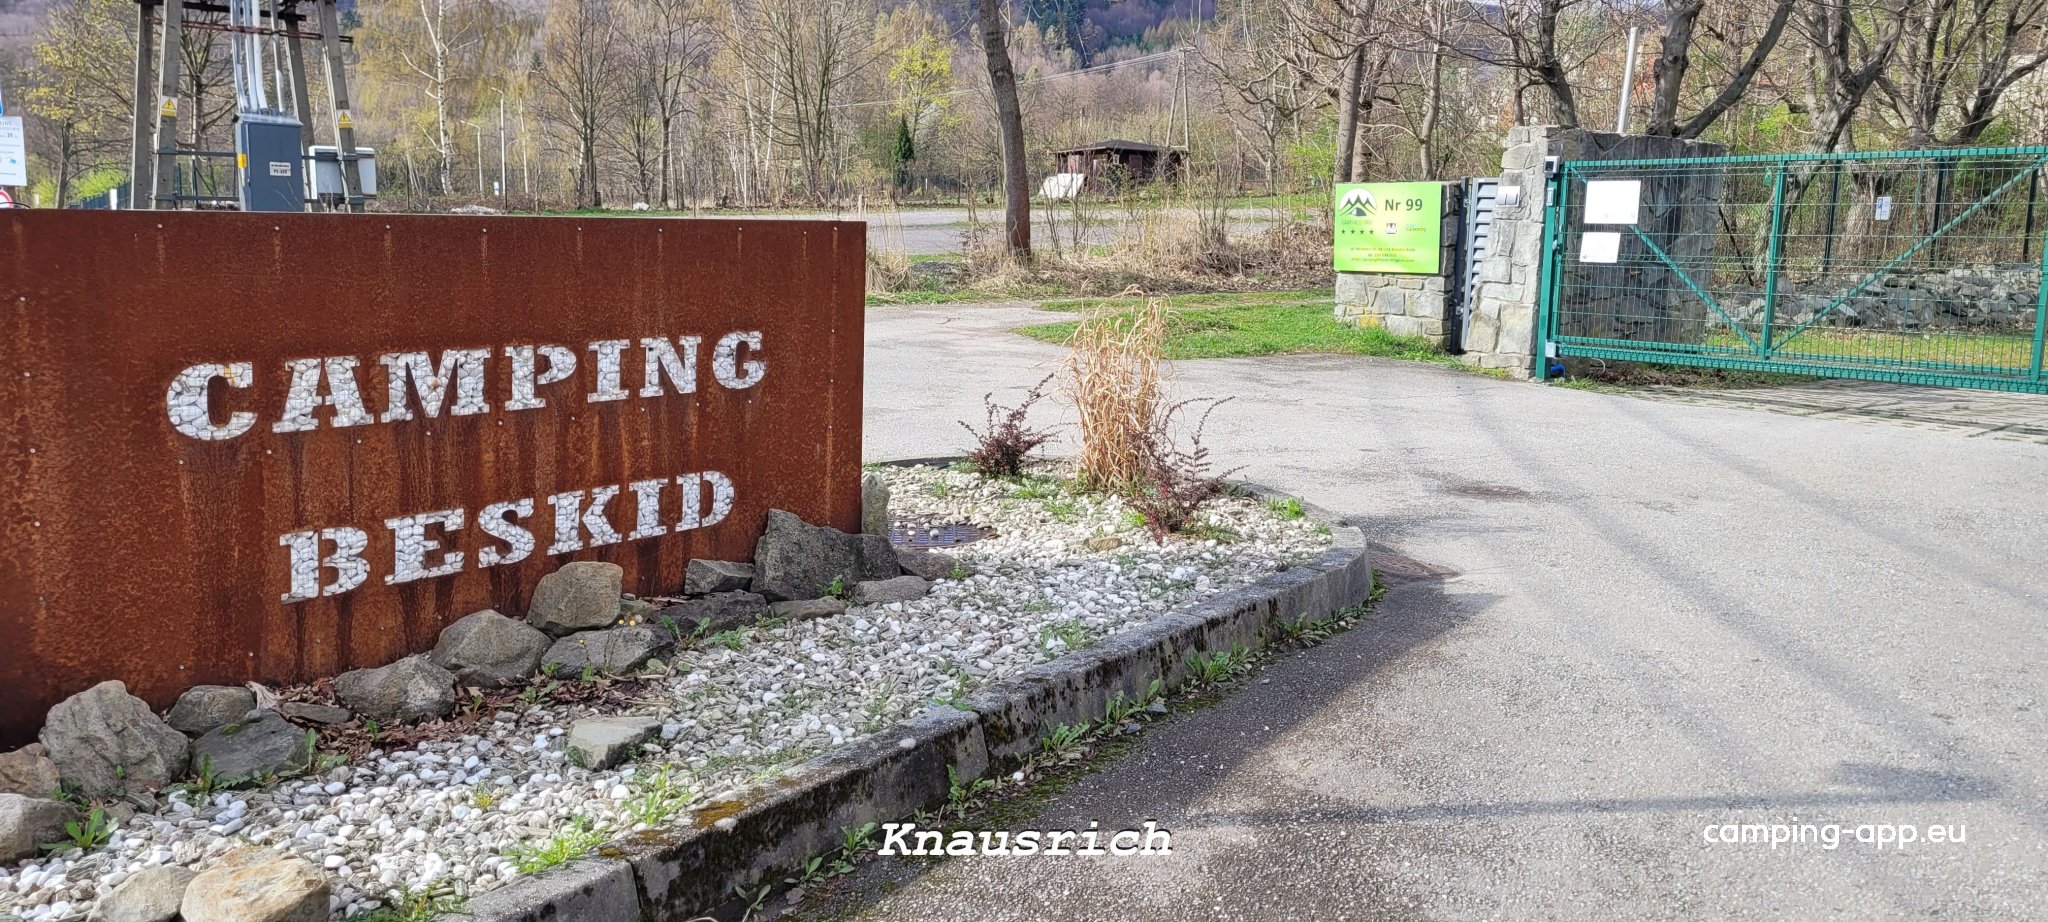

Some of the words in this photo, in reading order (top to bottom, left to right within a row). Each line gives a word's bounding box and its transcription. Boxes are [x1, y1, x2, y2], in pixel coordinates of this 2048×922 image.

[1385, 198, 1401, 211] Nr
[1405, 198, 1423, 211] 99
[165, 330, 767, 441] CAMPING
[278, 470, 736, 603] BESKID
